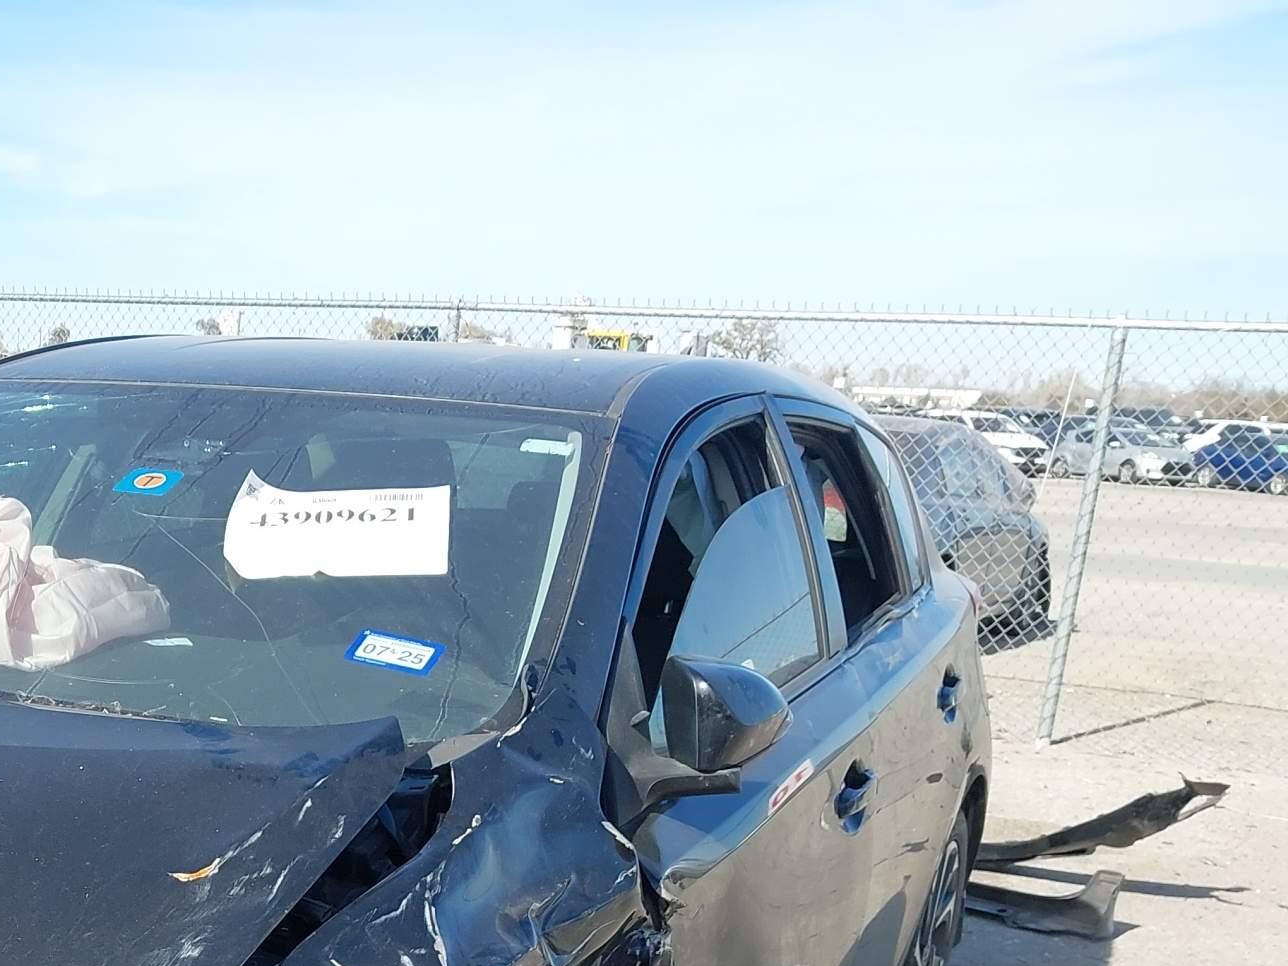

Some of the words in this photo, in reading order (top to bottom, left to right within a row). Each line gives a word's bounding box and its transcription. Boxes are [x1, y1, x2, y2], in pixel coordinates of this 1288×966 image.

[249, 507, 415, 527] 43909621
[362, 643, 390, 657] 07
[396, 650, 426, 665] 25
